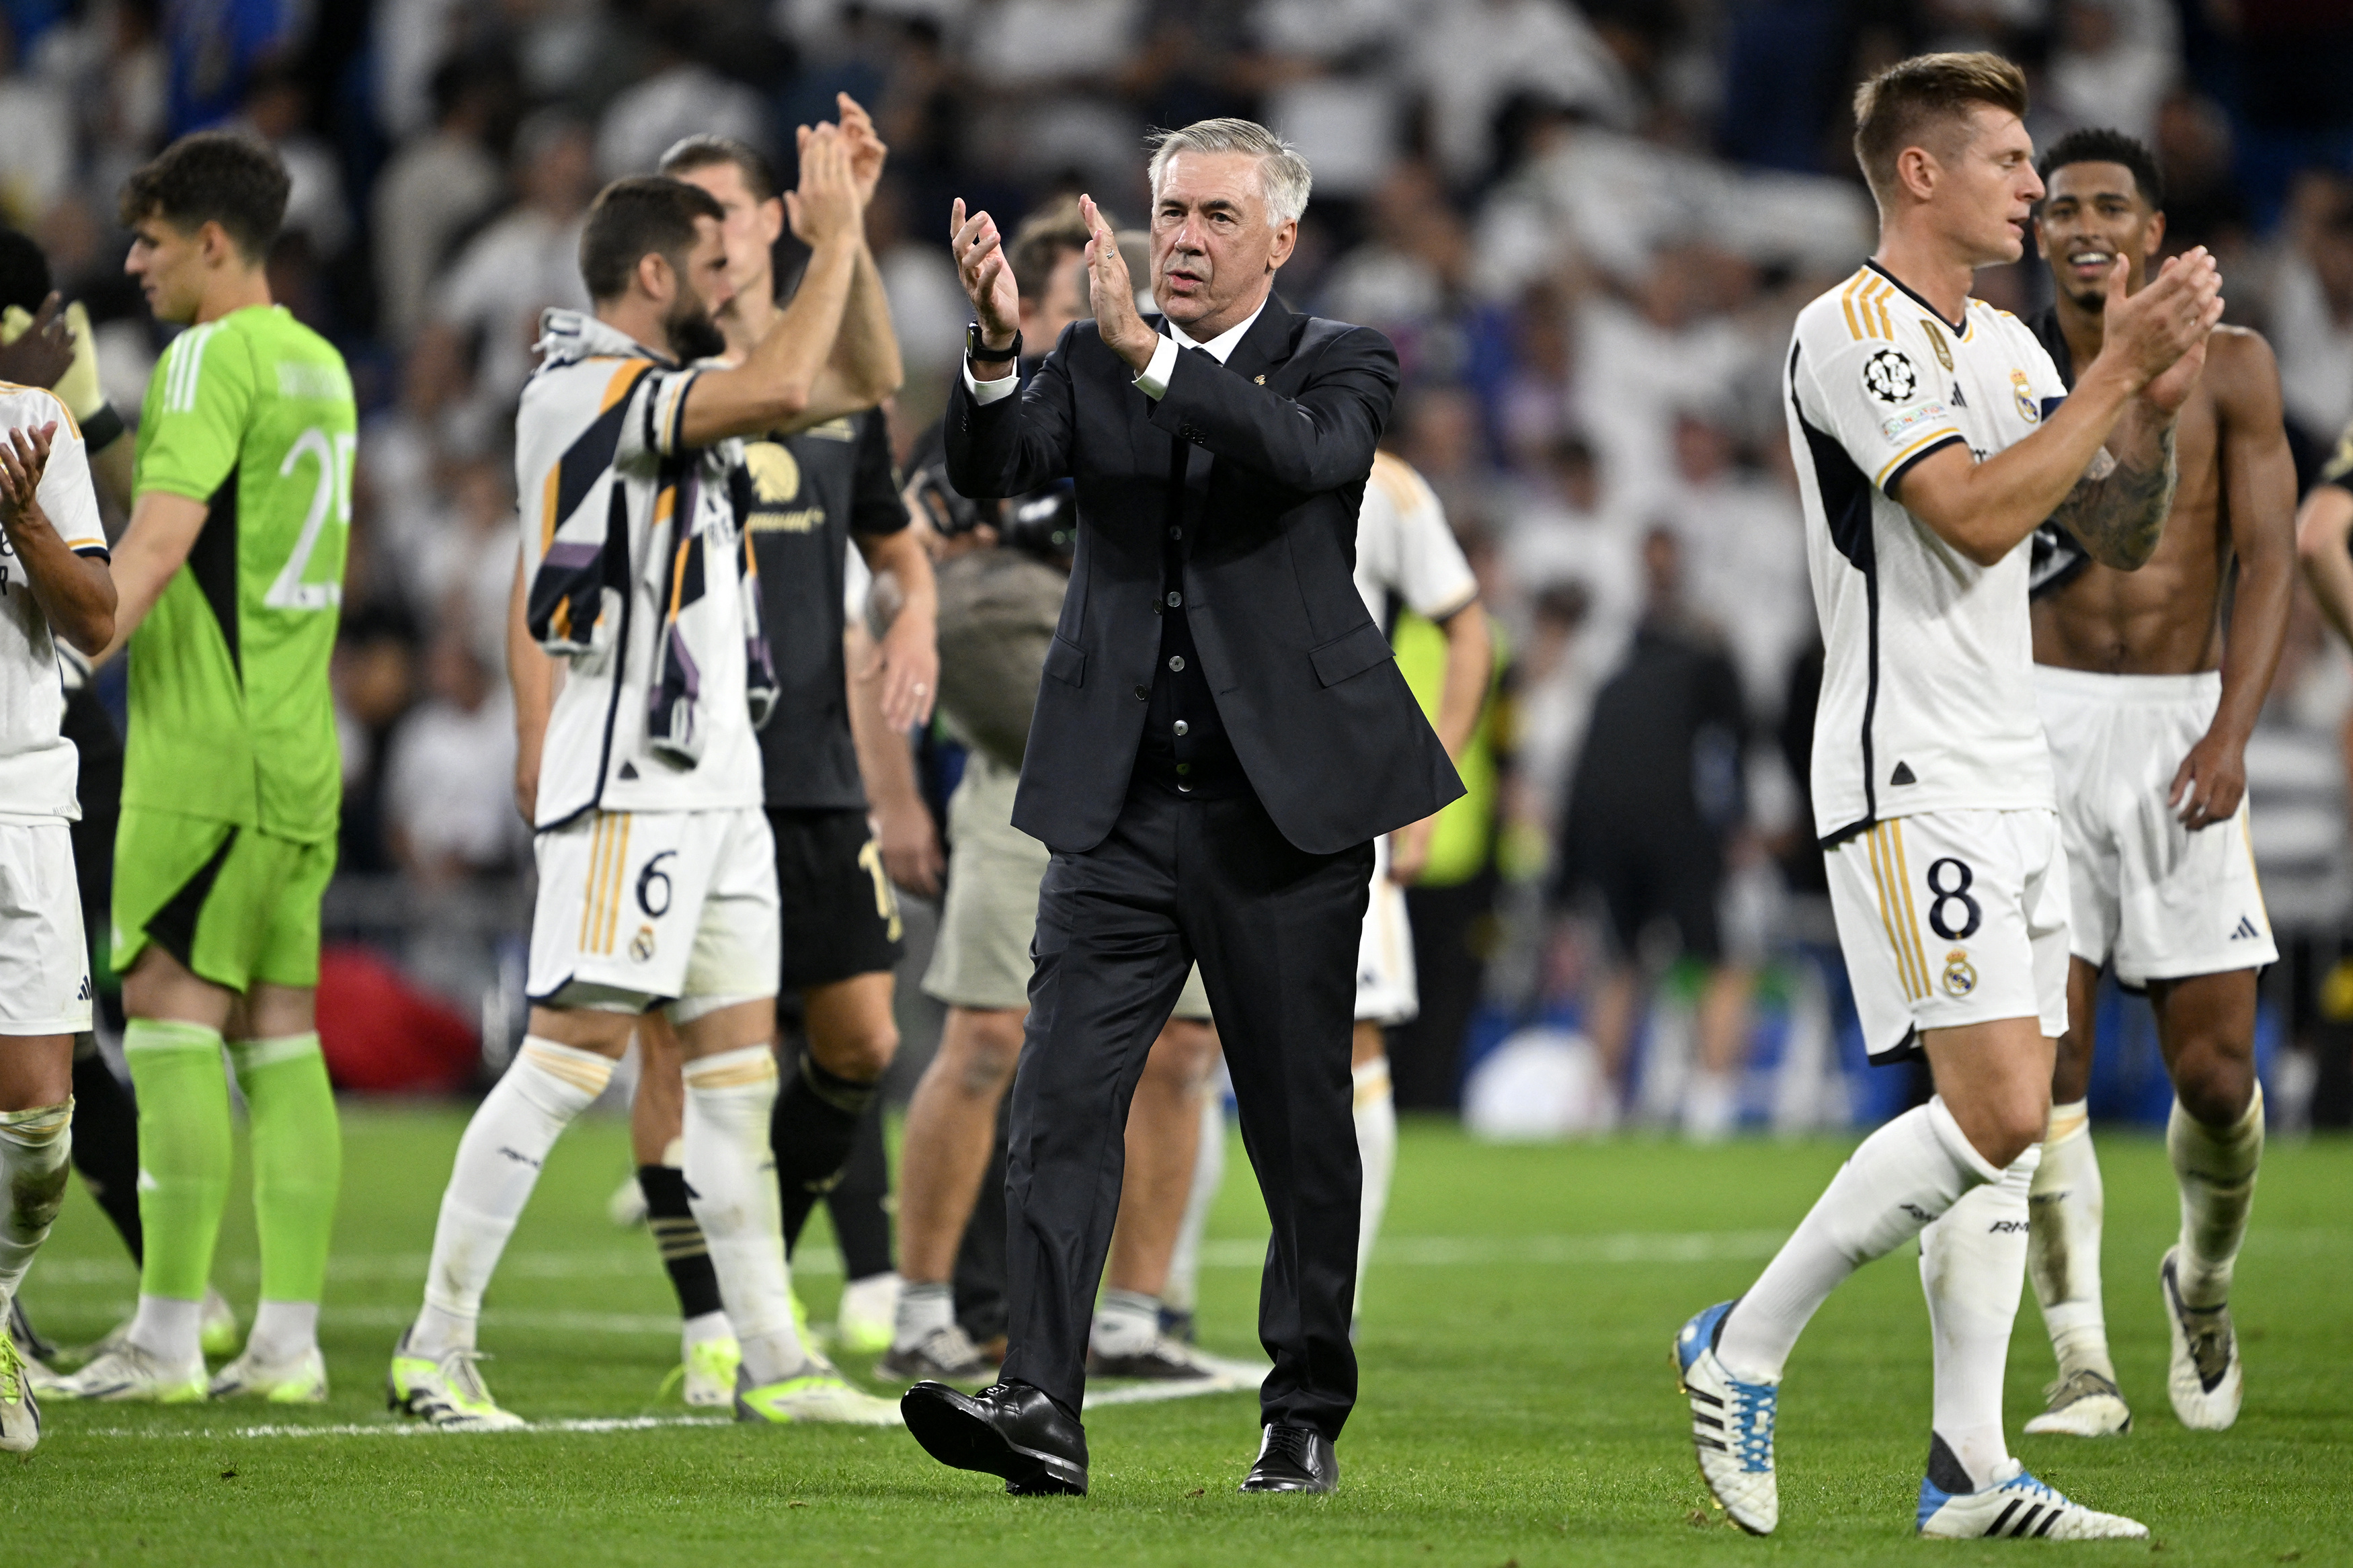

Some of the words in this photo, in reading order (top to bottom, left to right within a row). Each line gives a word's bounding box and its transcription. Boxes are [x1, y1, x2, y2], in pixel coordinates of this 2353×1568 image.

[636, 850, 678, 918] 6
[858, 841, 898, 919] 1
[1927, 858, 1982, 940] 8
[1989, 1221, 2029, 1233] RM
